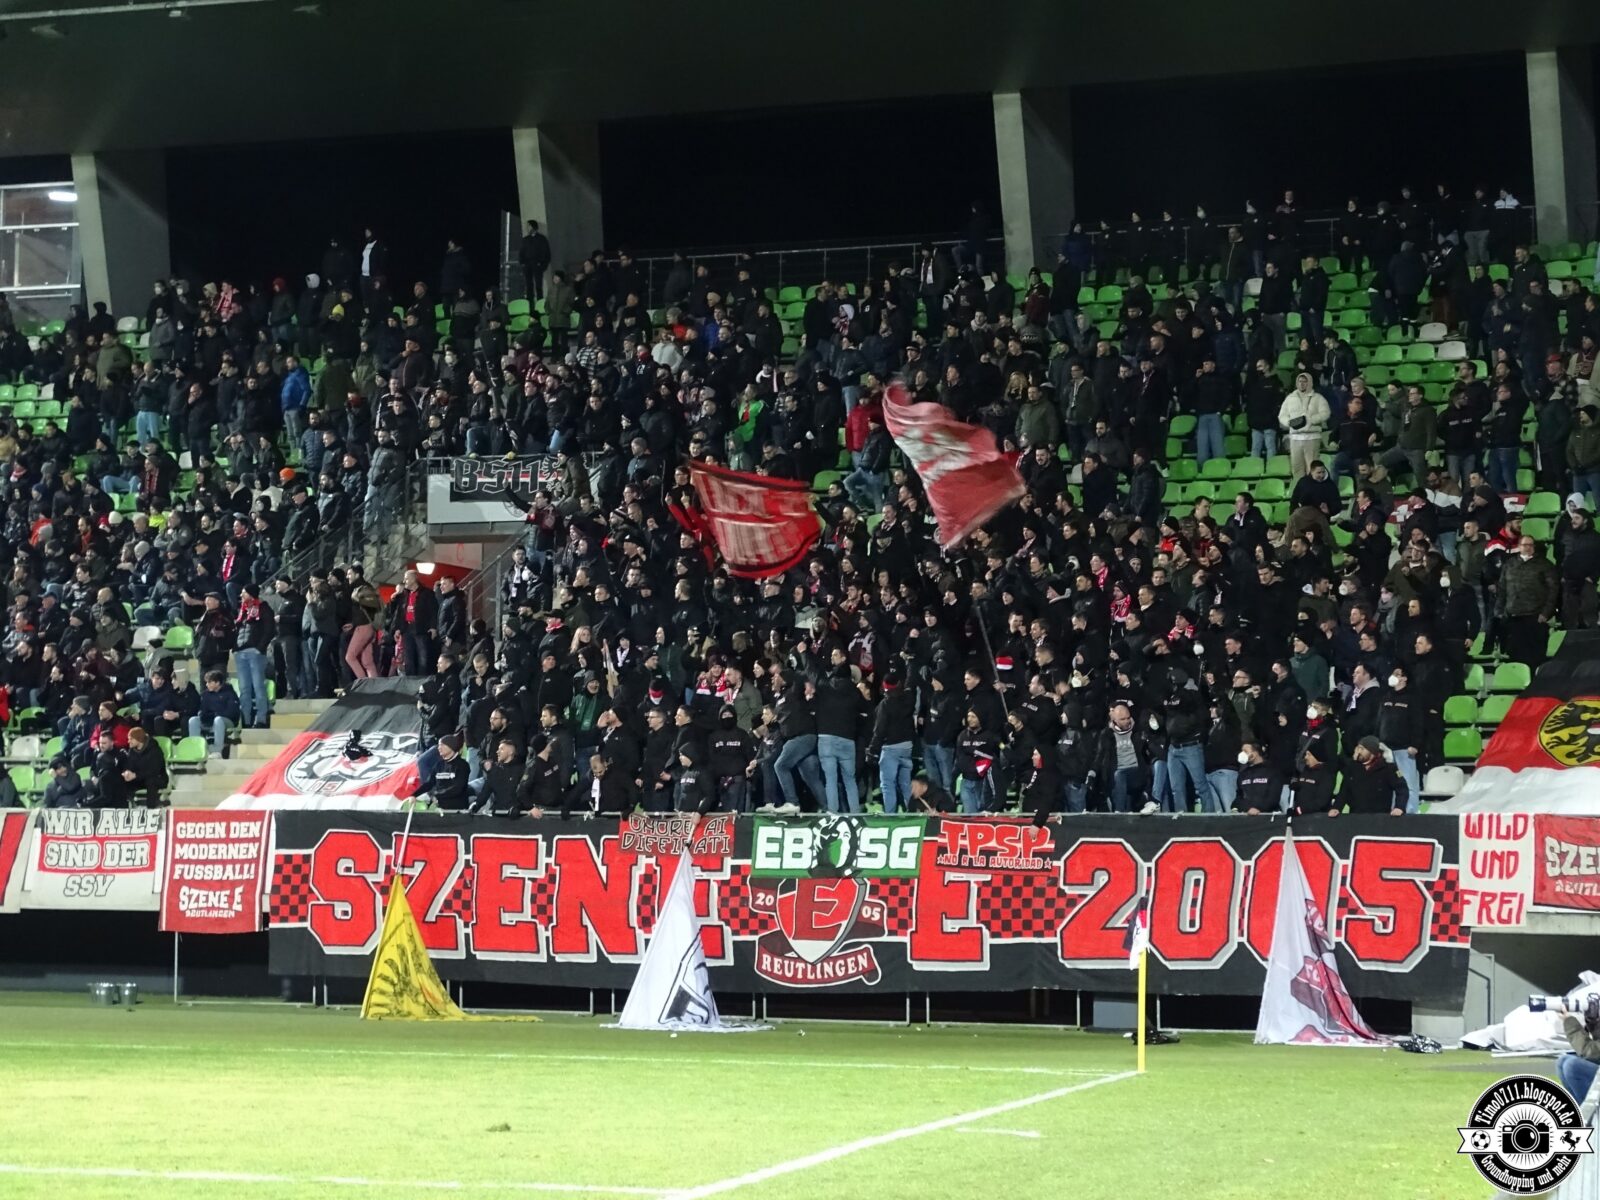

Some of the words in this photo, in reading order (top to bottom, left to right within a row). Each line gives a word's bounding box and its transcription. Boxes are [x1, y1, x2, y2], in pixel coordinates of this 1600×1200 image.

[43, 809, 93, 836] WIR
[97, 809, 159, 836] ALLE
[176, 821, 226, 838] GEGEN
[229, 821, 261, 838] DEN
[704, 817, 728, 836] AI
[1464, 813, 1529, 840] WILD
[174, 842, 259, 859] MODERNEN
[940, 820, 1051, 859] TPSP
[46, 842, 100, 867] SIND
[103, 842, 149, 867] DER
[943, 853, 958, 865] NO
[961, 855, 969, 866] A
[973, 856, 986, 867] LA
[989, 856, 1043, 870] AUTORIDAD
[1471, 850, 1519, 879] UND
[1545, 835, 1600, 877] SZE
[173, 864, 255, 880] FUSSBALL!
[63, 875, 115, 897] SSV
[179, 885, 230, 911] SZENE
[755, 892, 775, 906] 20
[861, 905, 881, 921] 05
[1058, 835, 1443, 972] 2005
[1460, 889, 1524, 925] FREI
[761, 952, 869, 980] REUTLINGEN
